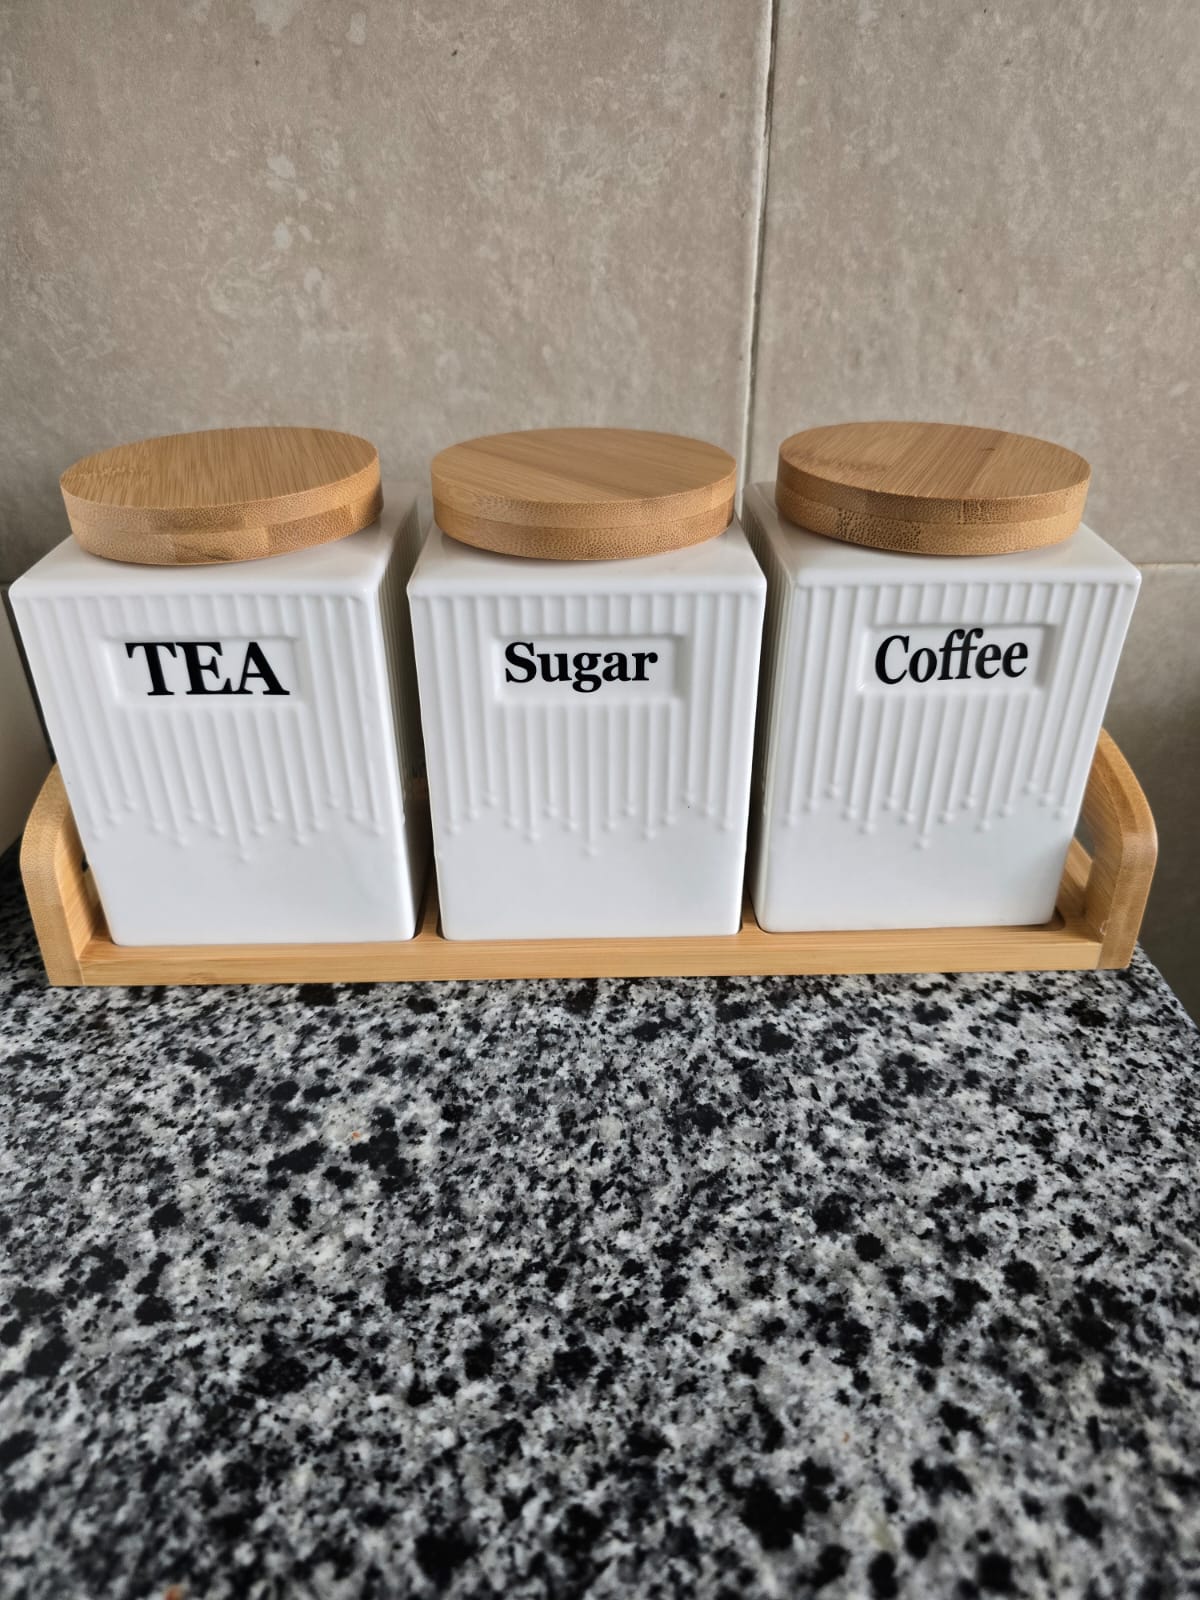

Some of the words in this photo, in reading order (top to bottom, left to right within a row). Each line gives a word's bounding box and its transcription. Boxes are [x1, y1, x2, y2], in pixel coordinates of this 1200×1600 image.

[125, 641, 291, 696] TEA
[504, 641, 659, 694] Sugar
[874, 627, 1029, 685] Coffee
